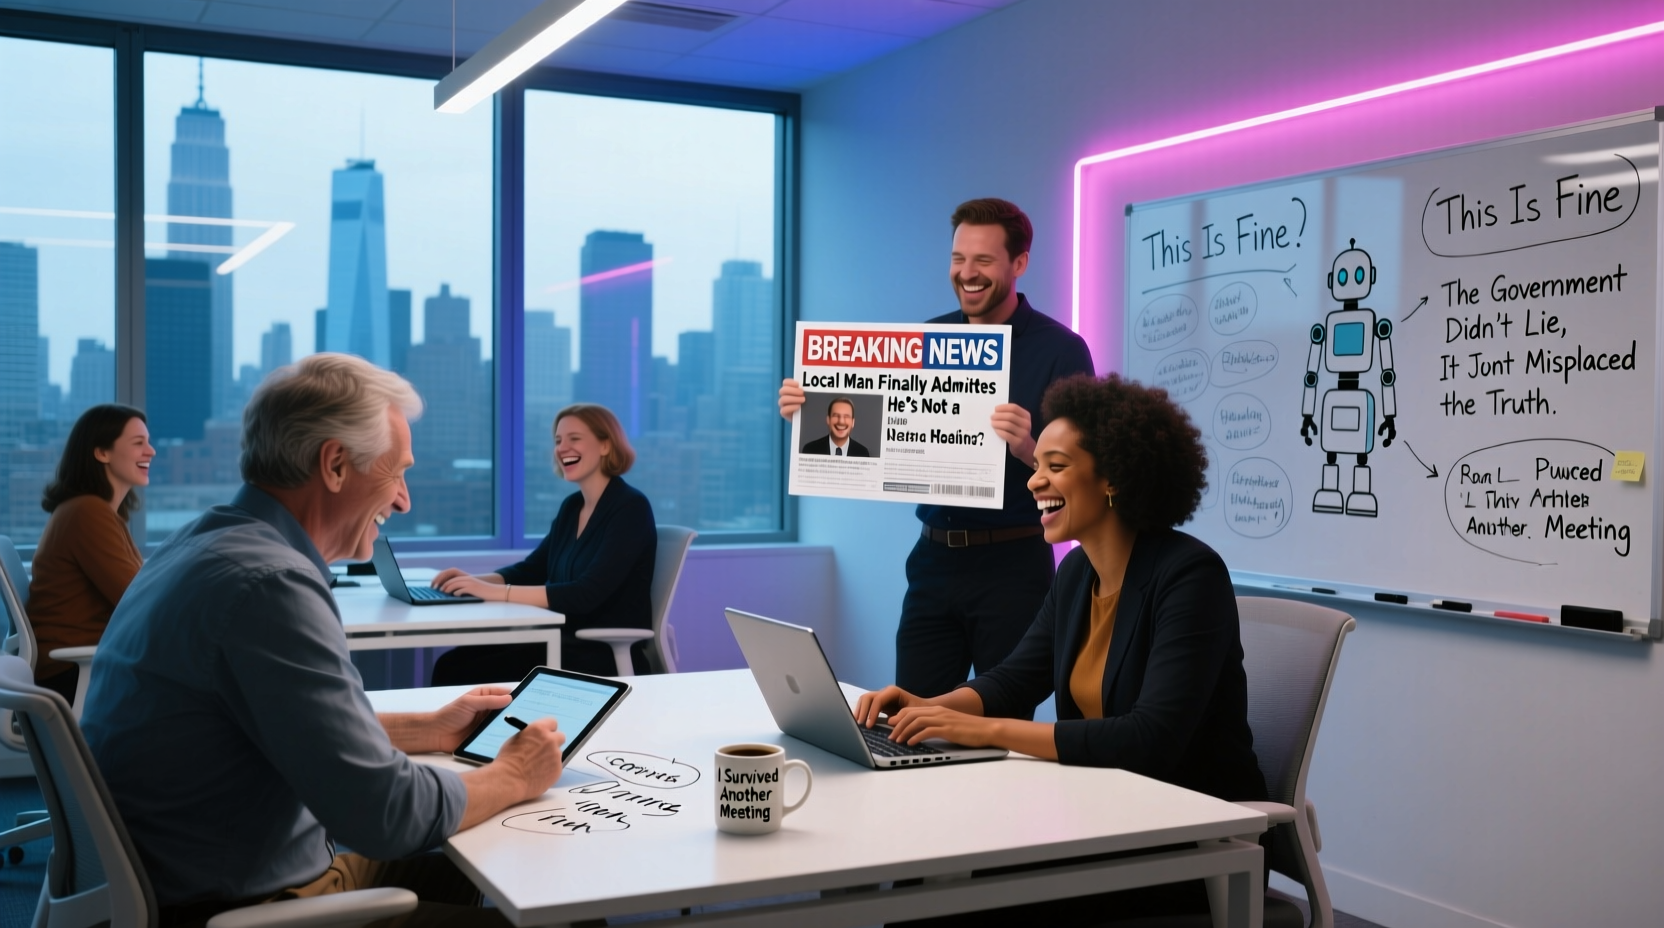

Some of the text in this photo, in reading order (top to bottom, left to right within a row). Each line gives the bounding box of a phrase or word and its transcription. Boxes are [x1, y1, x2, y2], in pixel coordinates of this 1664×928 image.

[1436, 174, 1623, 234] This Is Fine
[1142, 197, 1307, 271] This Is Fine?
[1441, 263, 1628, 307] The Government
[1446, 309, 1567, 343] Didn't Lie,
[807, 334, 999, 366] BREAKING NEWS
[1440, 355, 1460, 381] It
[1526, 340, 1636, 384] Misplaced
[802, 371, 840, 389] Local
[843, 373, 874, 390] Man
[878, 374, 927, 395] Finally
[888, 396, 960, 415] He's Not a
[1440, 387, 1557, 416] the Truth.
[1545, 514, 1631, 557] Meeting
[718, 767, 779, 784] I Survived
[720, 786, 773, 802] Another
[720, 804, 771, 822] Meeting
